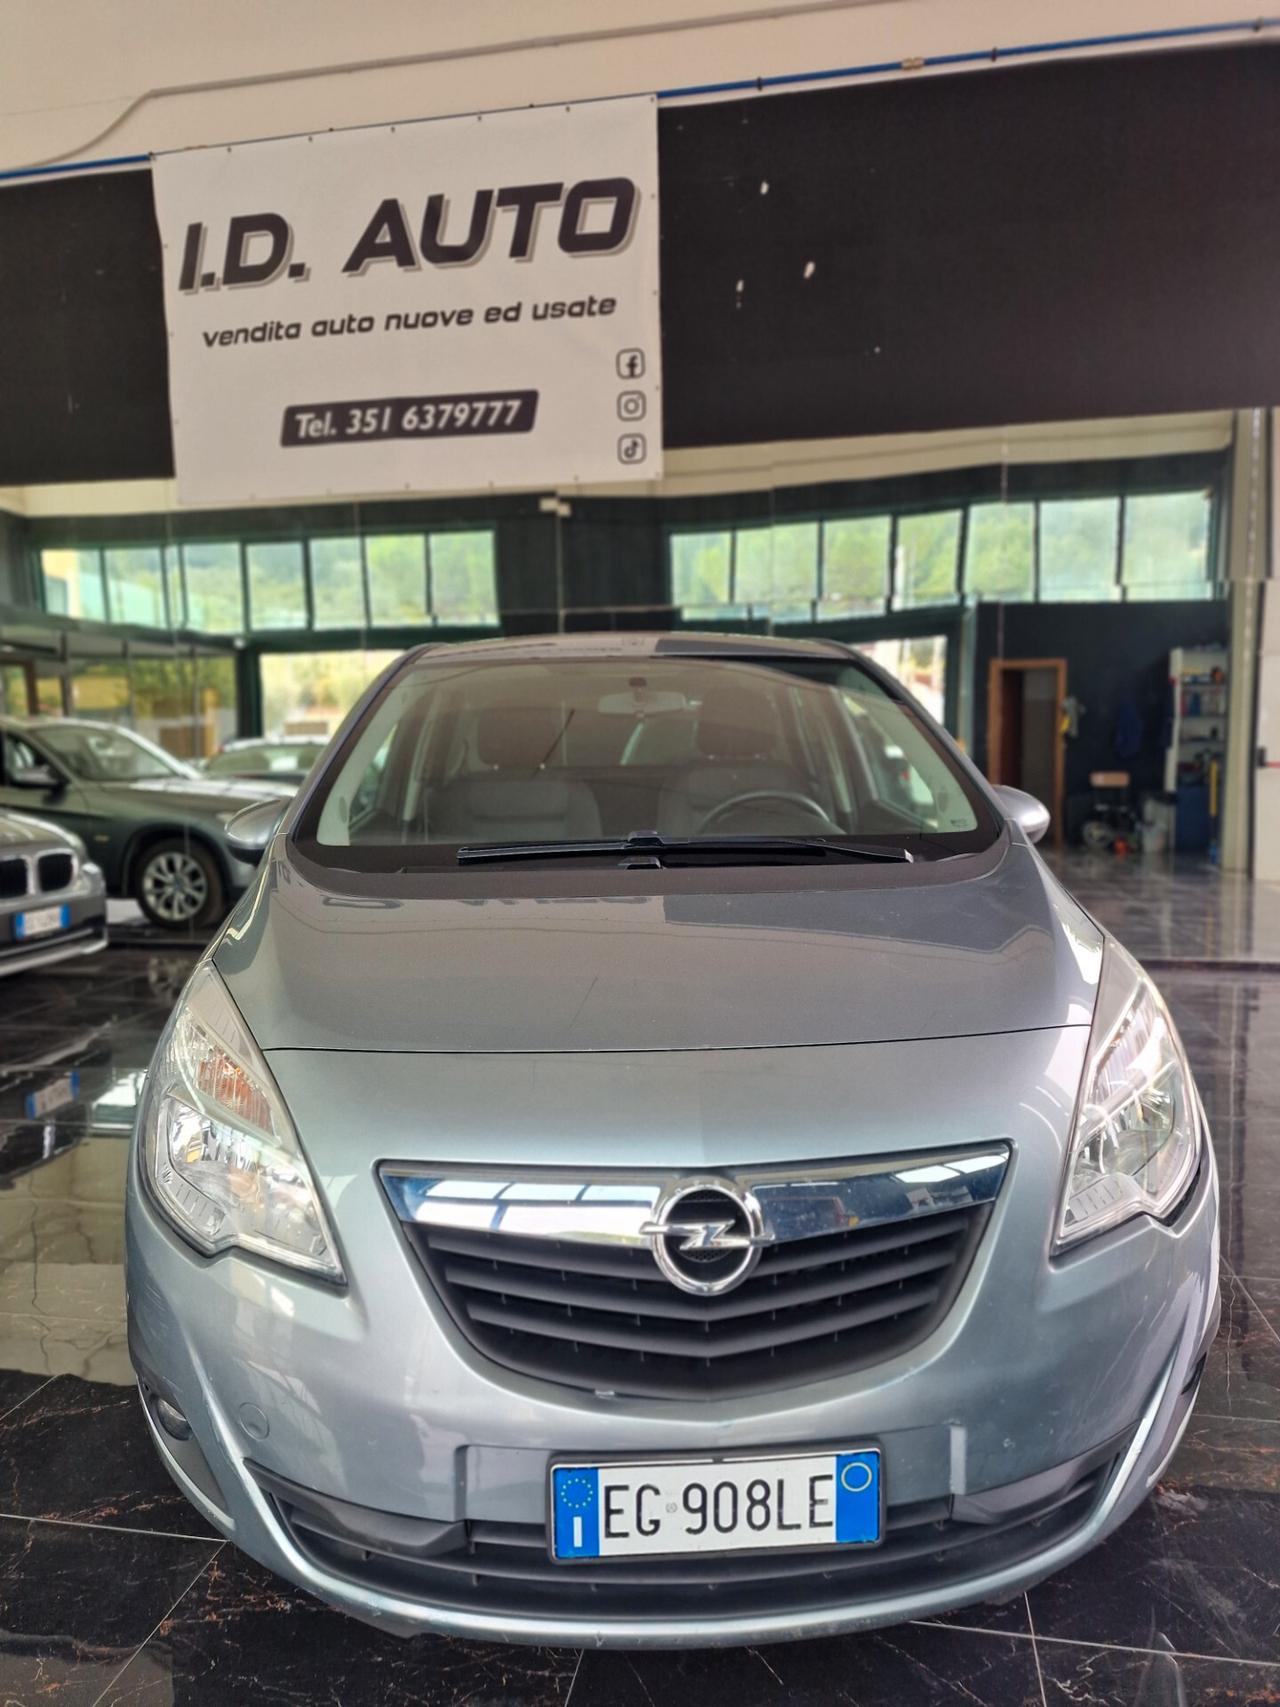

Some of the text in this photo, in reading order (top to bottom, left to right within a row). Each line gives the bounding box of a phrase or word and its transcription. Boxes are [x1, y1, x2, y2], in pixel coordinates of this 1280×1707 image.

[178, 177, 640, 293] I.D. AUTO
[202, 295, 617, 348] vendita auto nuove ed usate
[295, 399, 523, 438] Tel. 351 6379777
[604, 1483, 661, 1539] EG
[682, 1474, 834, 1535] 908LE
